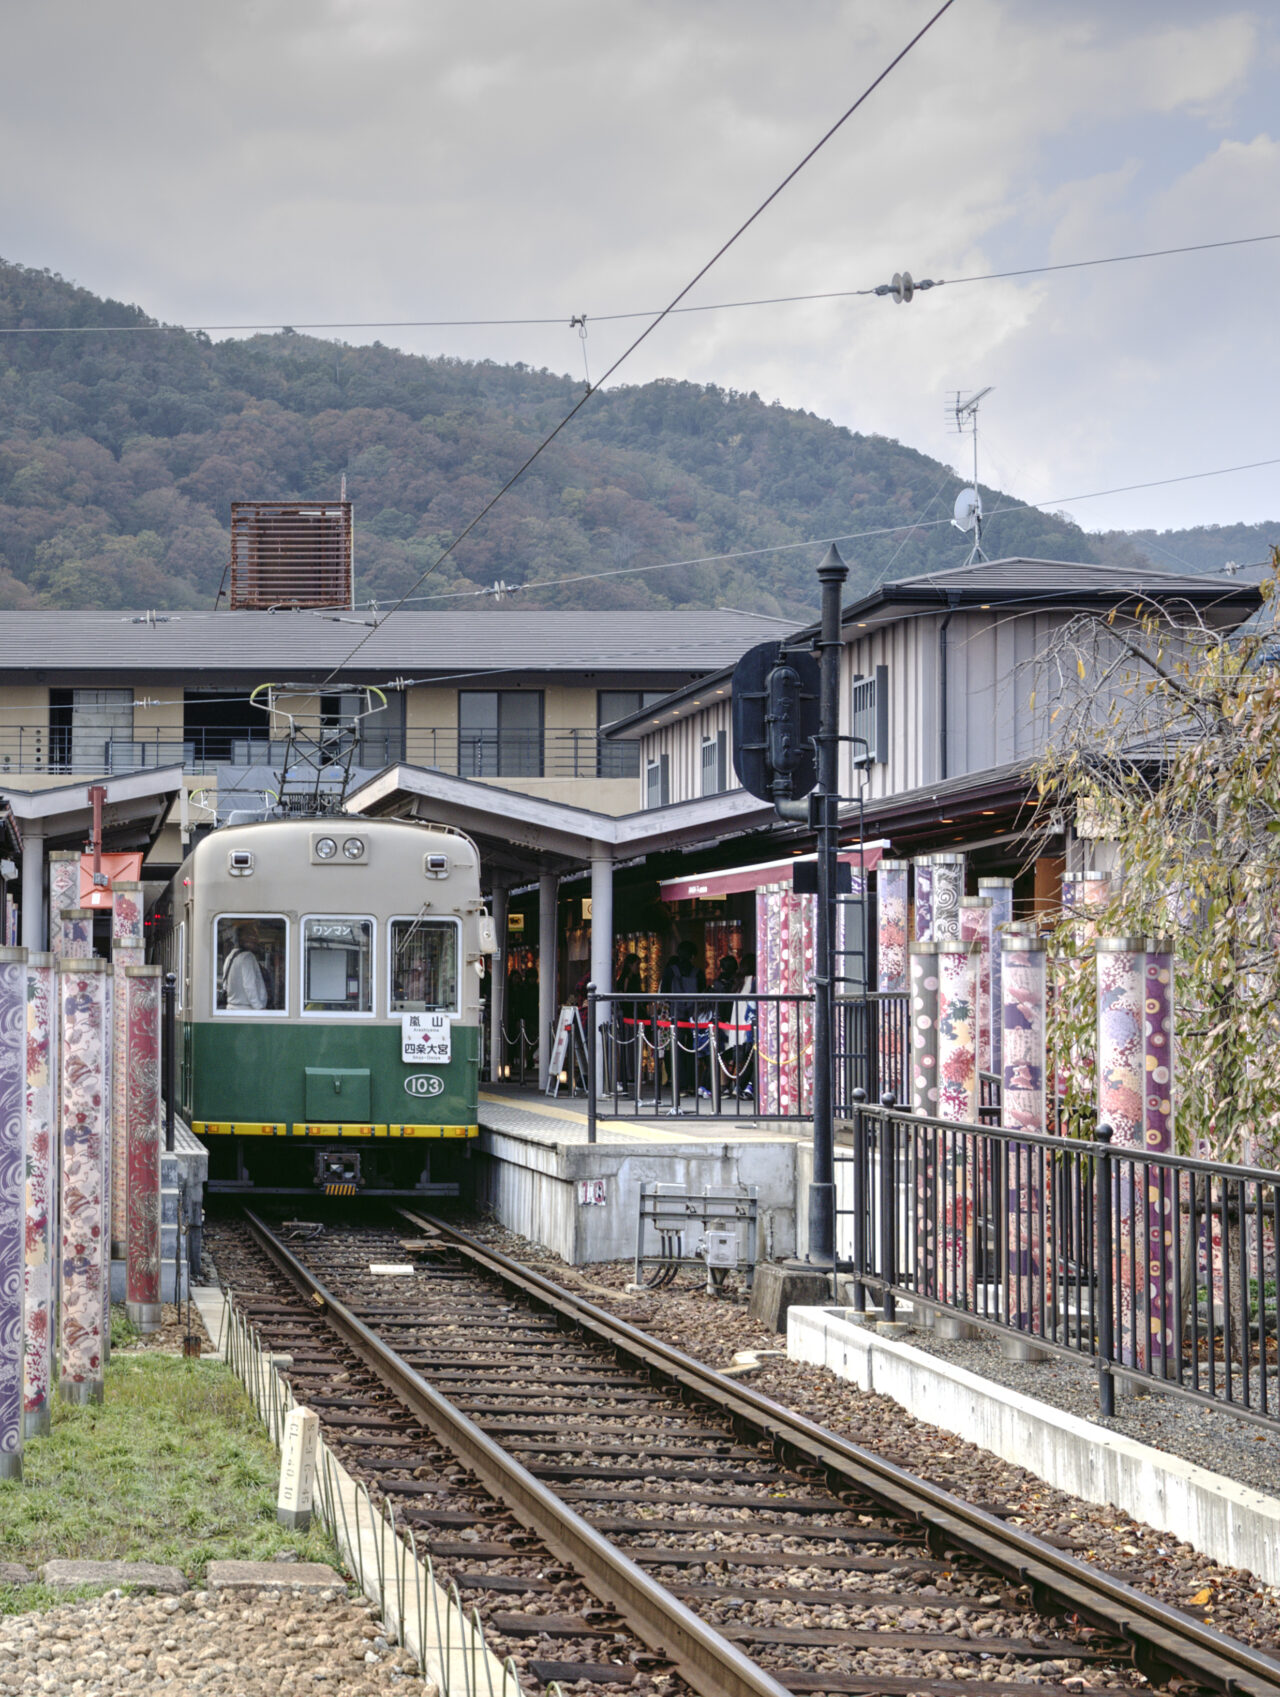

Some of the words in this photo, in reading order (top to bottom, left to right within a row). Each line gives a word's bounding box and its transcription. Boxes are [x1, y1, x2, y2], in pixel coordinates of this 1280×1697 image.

[313, 926, 351, 936] ワンマン
[404, 1043, 449, 1056] 四条大宮
[411, 1078, 440, 1093] 103
